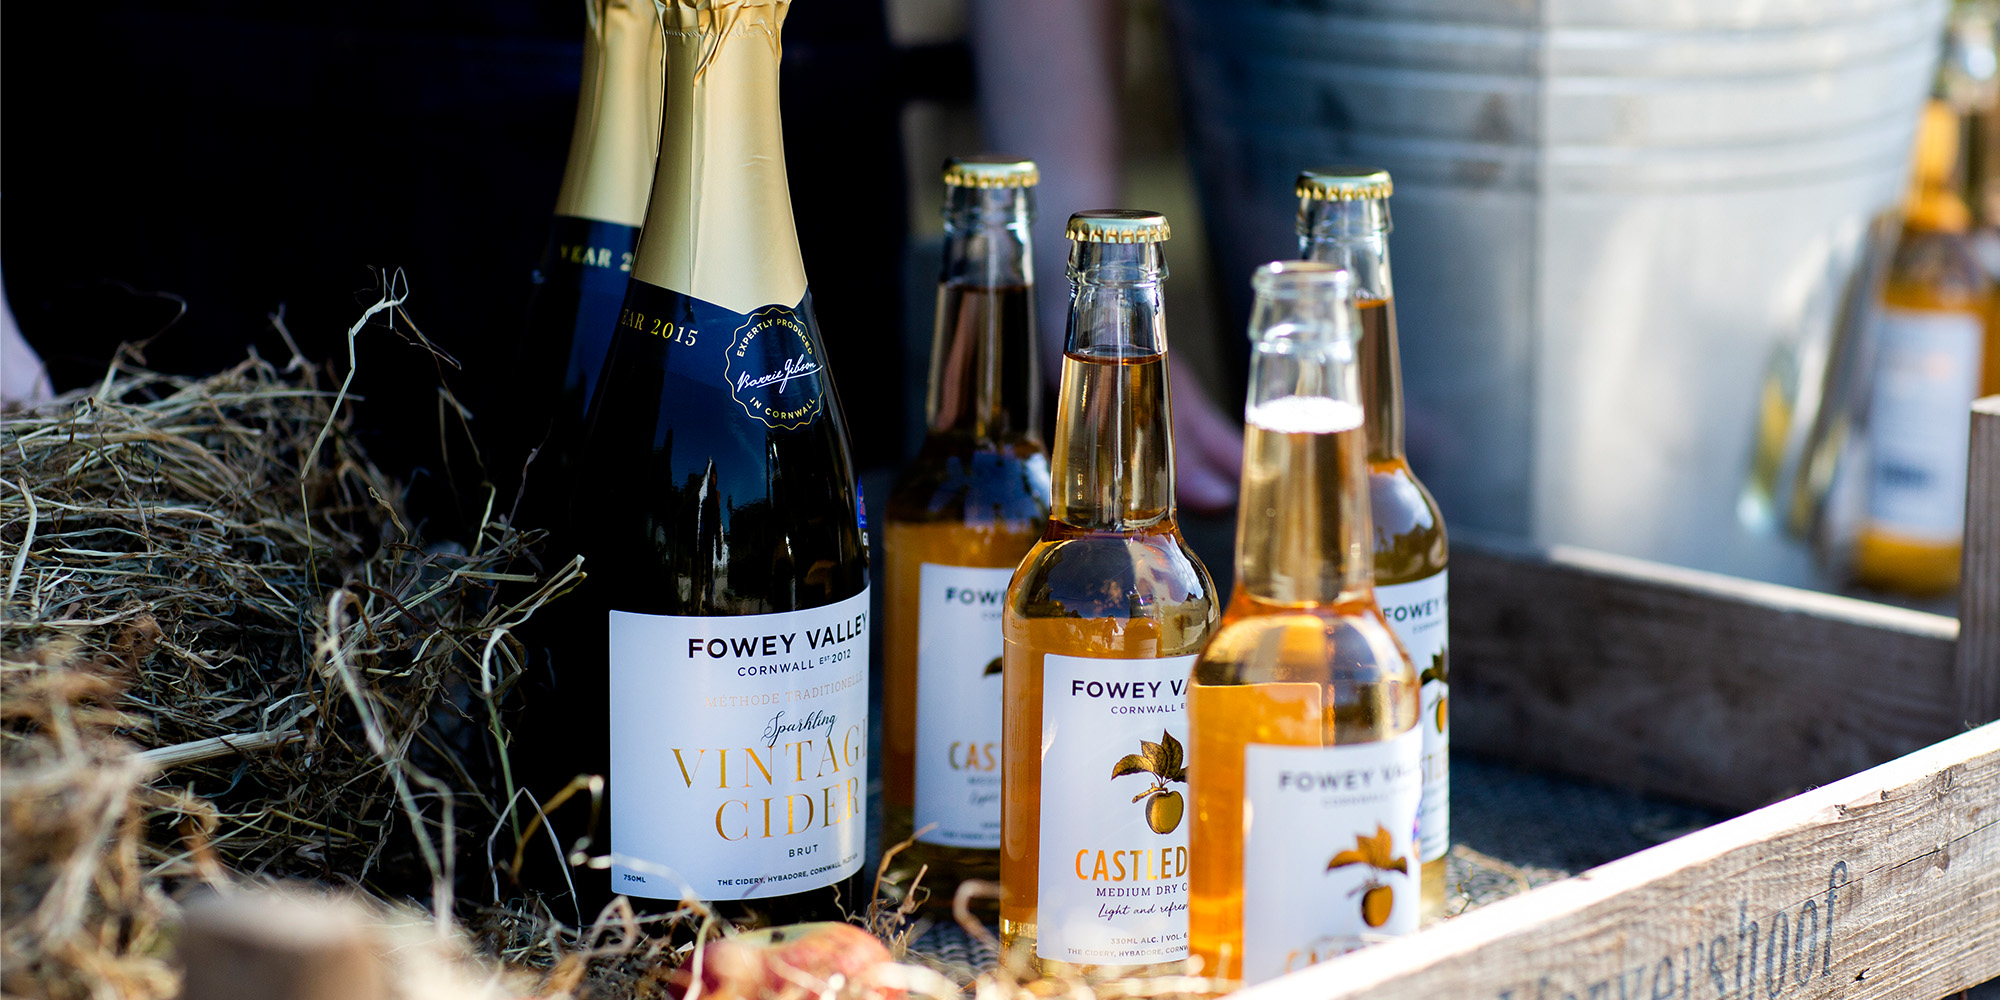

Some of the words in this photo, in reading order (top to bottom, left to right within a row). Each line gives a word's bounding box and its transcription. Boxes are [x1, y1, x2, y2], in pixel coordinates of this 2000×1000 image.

[650, 318, 699, 347] 2015
[736, 318, 774, 358] EXPERTLY
[776, 318, 813, 355] PRODUCED
[749, 396, 763, 410] IN
[764, 398, 816, 420] CORNWALL
[688, 632, 797, 659] FOWEY
[805, 609, 868, 650] VALLEY
[737, 659, 815, 677] CORNWALL
[705, 692, 780, 708] MÉTHODE
[785, 670, 864, 702] TRADITIONELLE
[1071, 680, 1162, 699] FOWEY
[1111, 704, 1176, 715] CORNWALL
[760, 709, 838, 748] Sparkling
[715, 776, 860, 842] CIDER
[788, 843, 819, 858] BRUT
[623, 873, 647, 883] 750ML
[1096, 887, 1151, 897] MEDIUM
[1156, 883, 1178, 896] DRY
[1098, 903, 1130, 921] Light
[1133, 903, 1156, 914] and
[1067, 947, 1082, 956] THE
